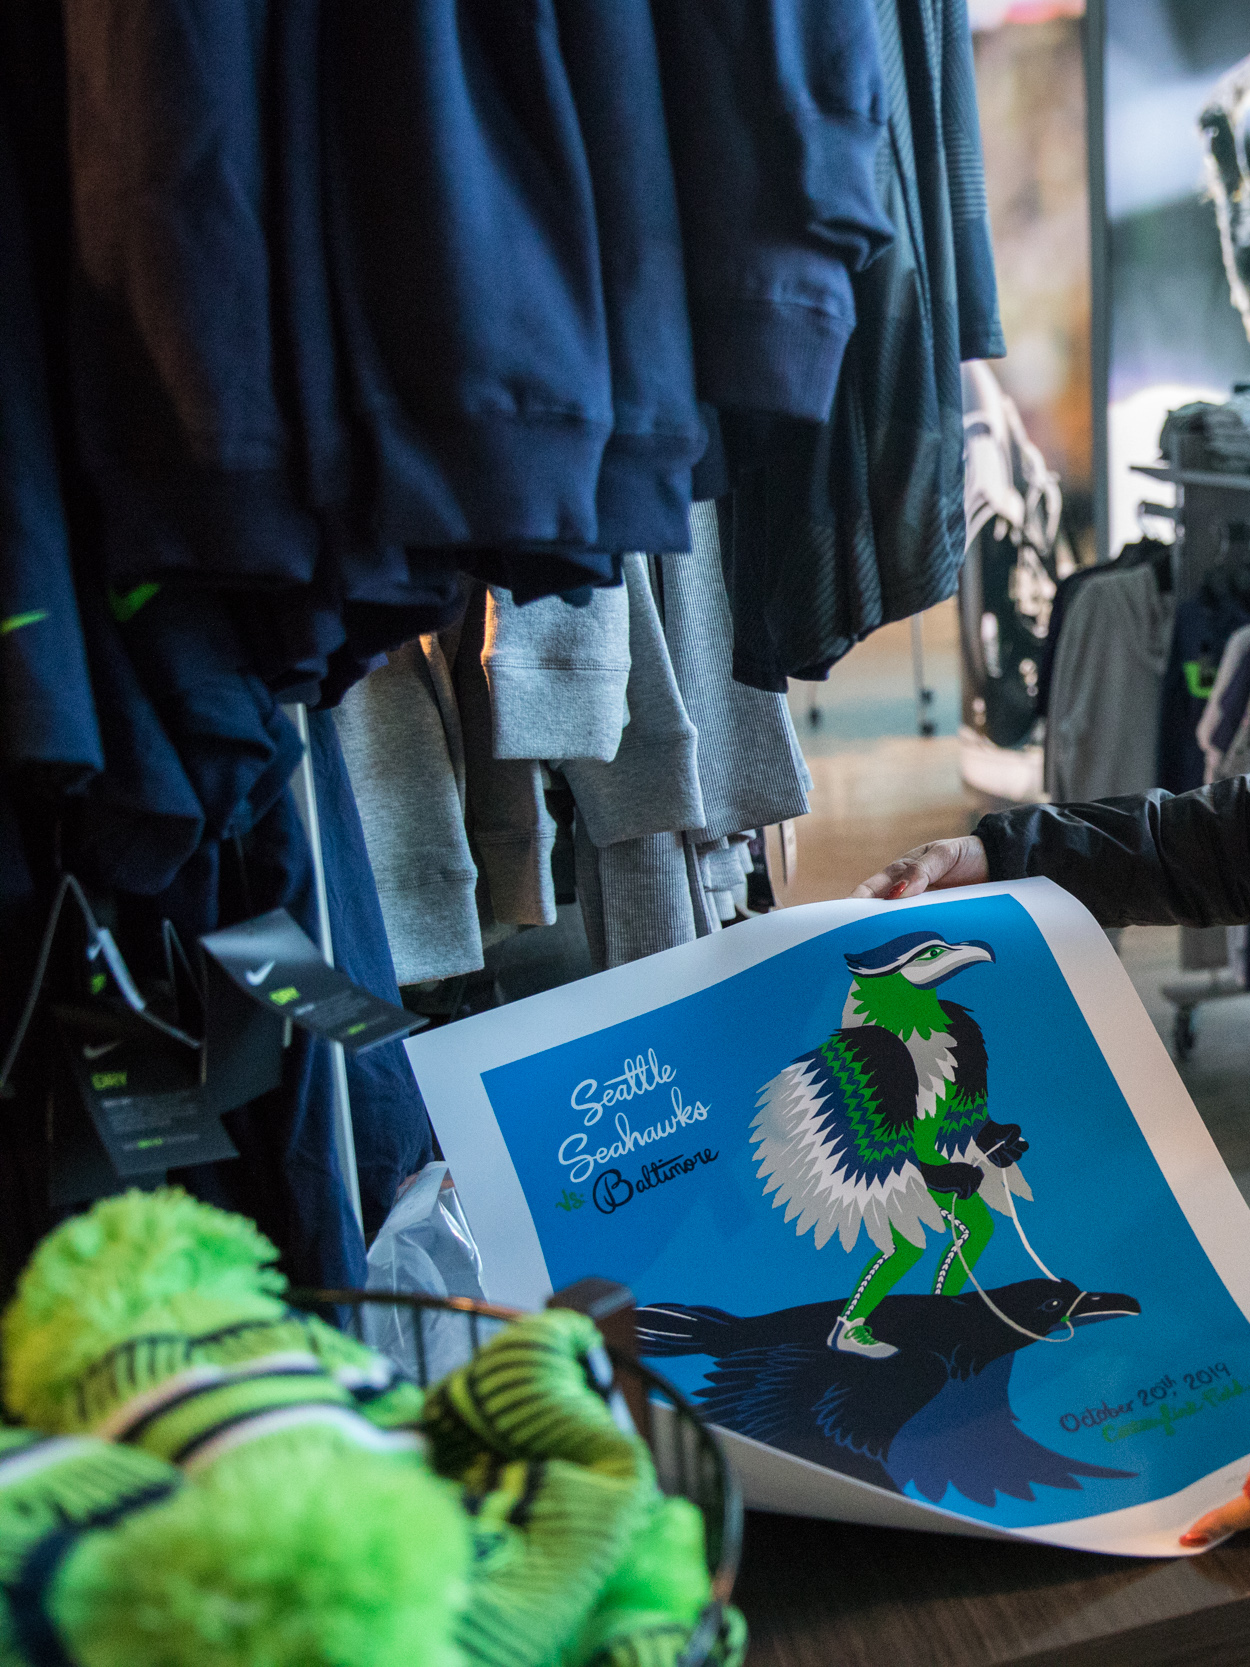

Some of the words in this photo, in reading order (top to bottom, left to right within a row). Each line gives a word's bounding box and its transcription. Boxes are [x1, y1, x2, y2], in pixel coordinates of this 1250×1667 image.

[571, 1047, 676, 1126] Seattle
[558, 1086, 712, 1183] Seahawks
[592, 1148, 720, 1215] Baltimore
[1059, 1400, 1133, 1433] October
[1183, 1362, 1231, 1391] 2019
